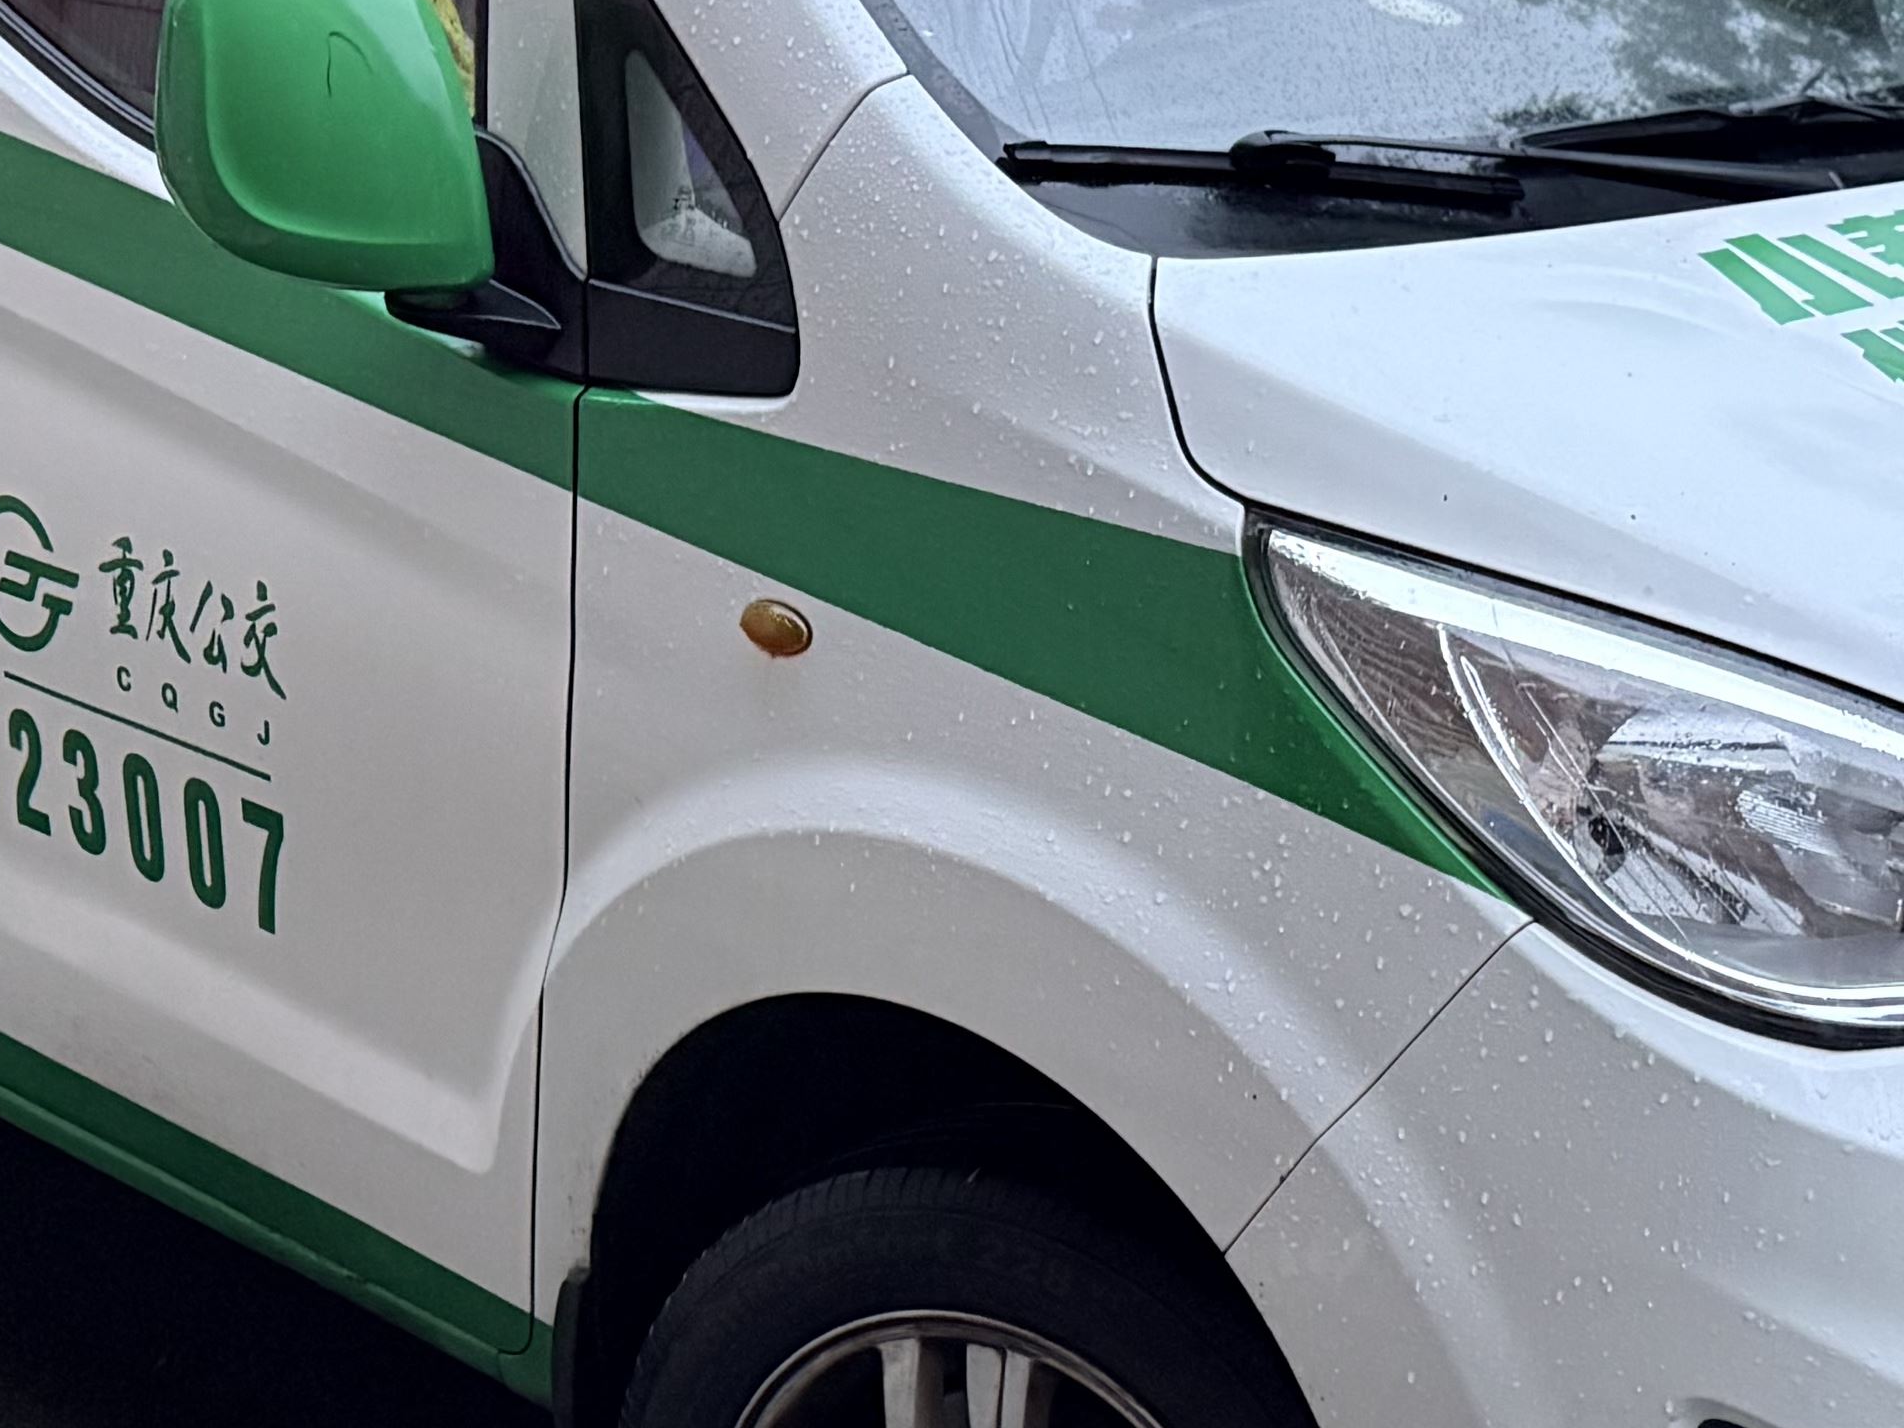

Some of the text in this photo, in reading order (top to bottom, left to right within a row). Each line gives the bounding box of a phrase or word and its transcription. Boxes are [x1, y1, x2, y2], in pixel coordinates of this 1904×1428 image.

[98, 536, 287, 700] 重庆公交
[8, 708, 284, 935] 23007
